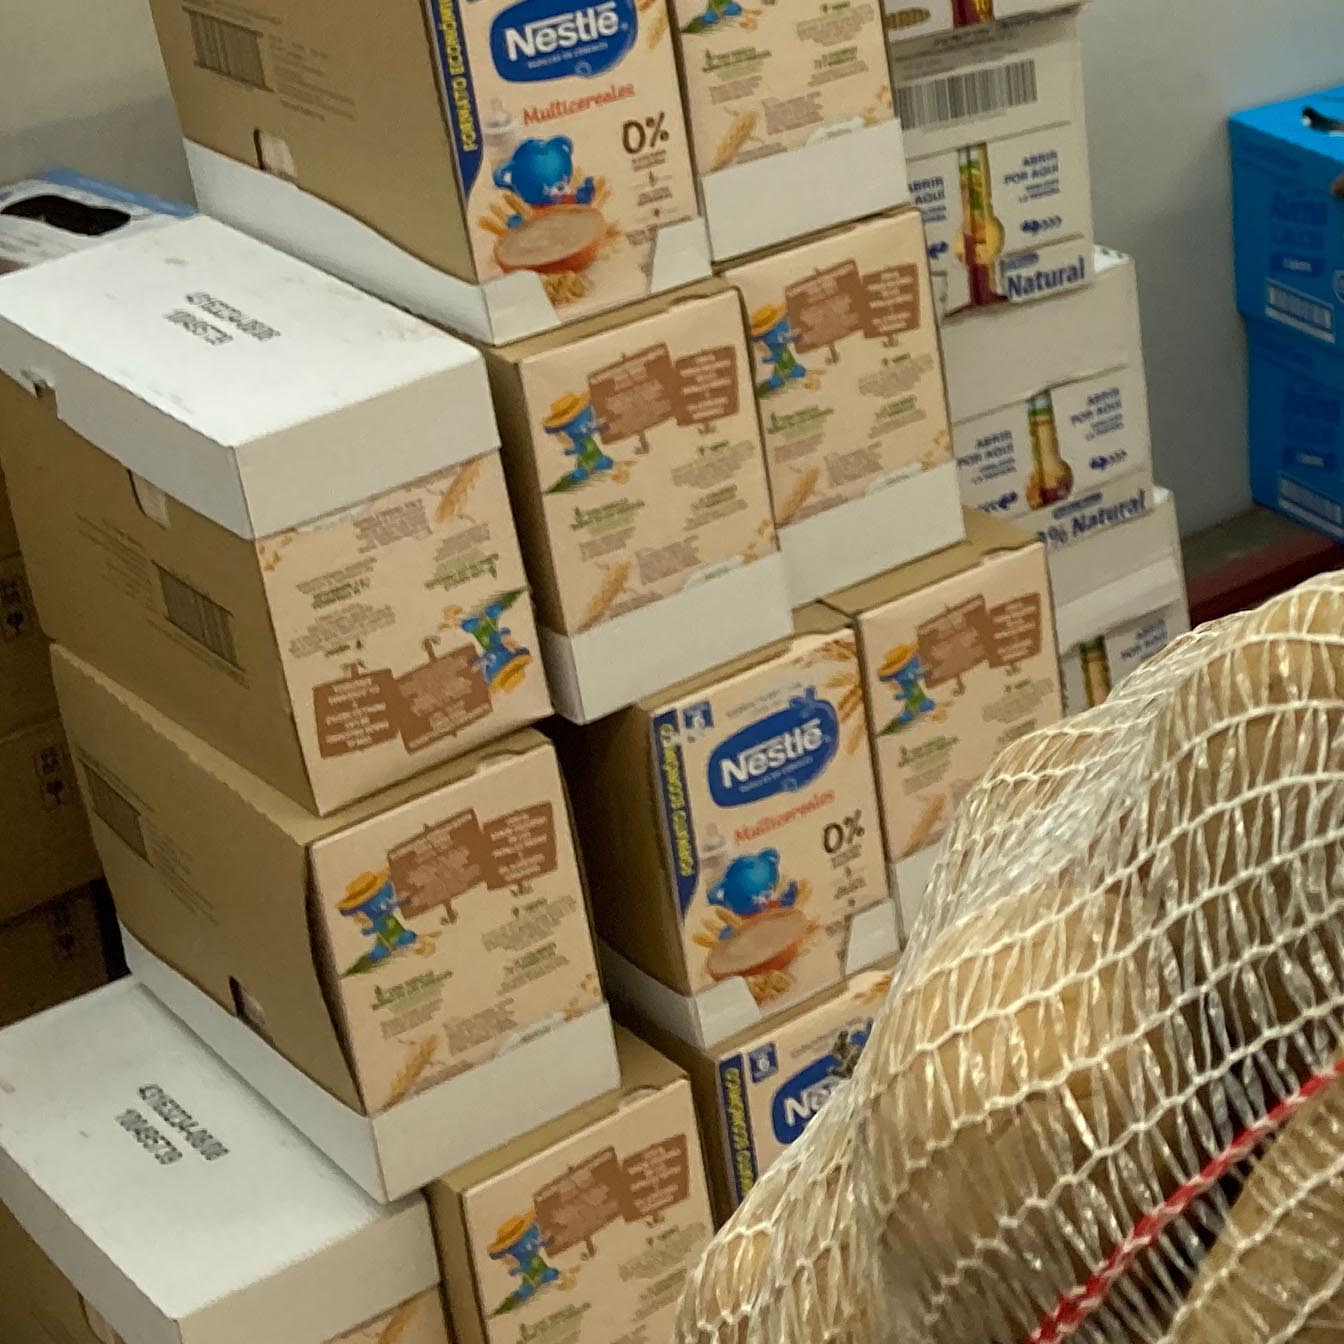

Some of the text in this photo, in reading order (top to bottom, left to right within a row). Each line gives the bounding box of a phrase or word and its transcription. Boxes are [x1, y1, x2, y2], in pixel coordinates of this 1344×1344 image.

[504, 0, 621, 63] Nestlé
[522, 82, 636, 128] Multicereales
[622, 111, 670, 156] 0%
[1006, 254, 1086, 298] Natural
[1071, 487, 1148, 537] Natural
[822, 808, 867, 854] 0%
